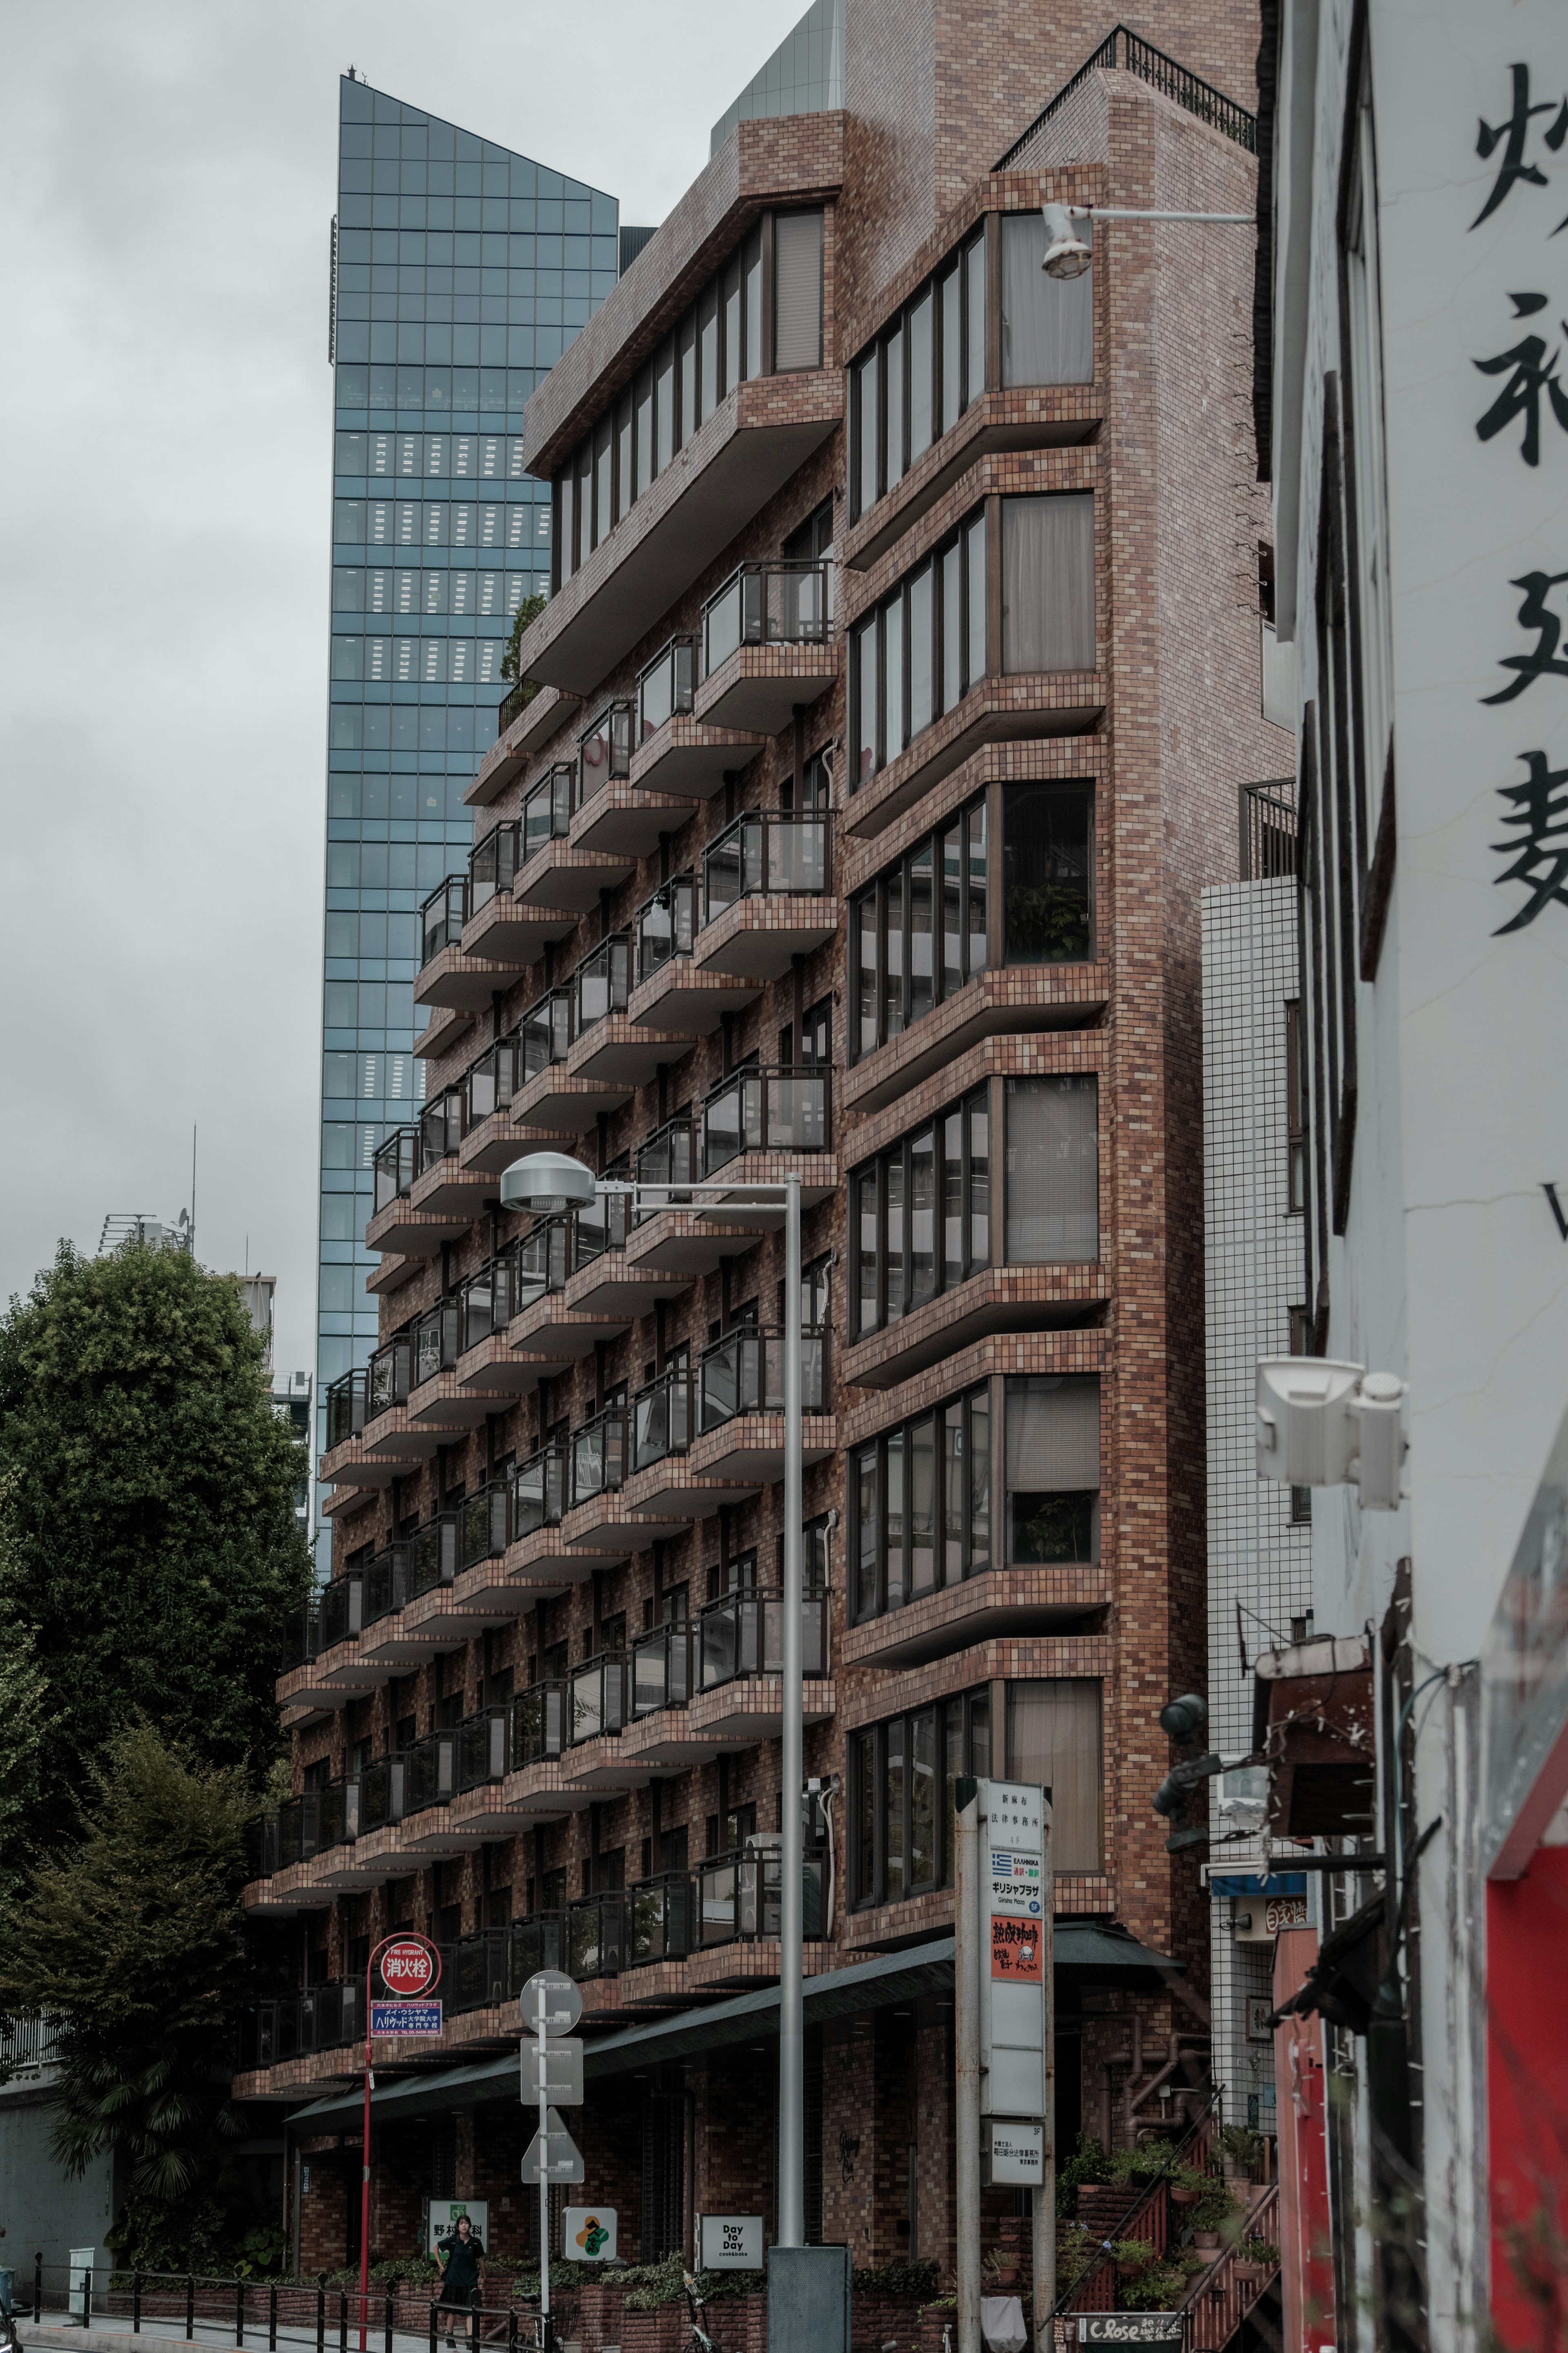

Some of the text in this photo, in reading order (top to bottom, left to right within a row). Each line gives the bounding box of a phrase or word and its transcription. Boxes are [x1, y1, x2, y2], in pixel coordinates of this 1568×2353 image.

[1002, 1794, 1027, 1806] 新麻布
[991, 1813, 1038, 1827] 法律事務所
[992, 1882, 1039, 1896] ギリシャプラザ
[387, 1958, 428, 1978] 消火栓
[376, 2016, 407, 2029] ハリウッド
[434, 2225, 482, 2237] 野村科
[723, 2225, 743, 2235] Day
[728, 2233, 738, 2241] to
[723, 2241, 743, 2251] Day
[1090, 2319, 1140, 2340] Close
